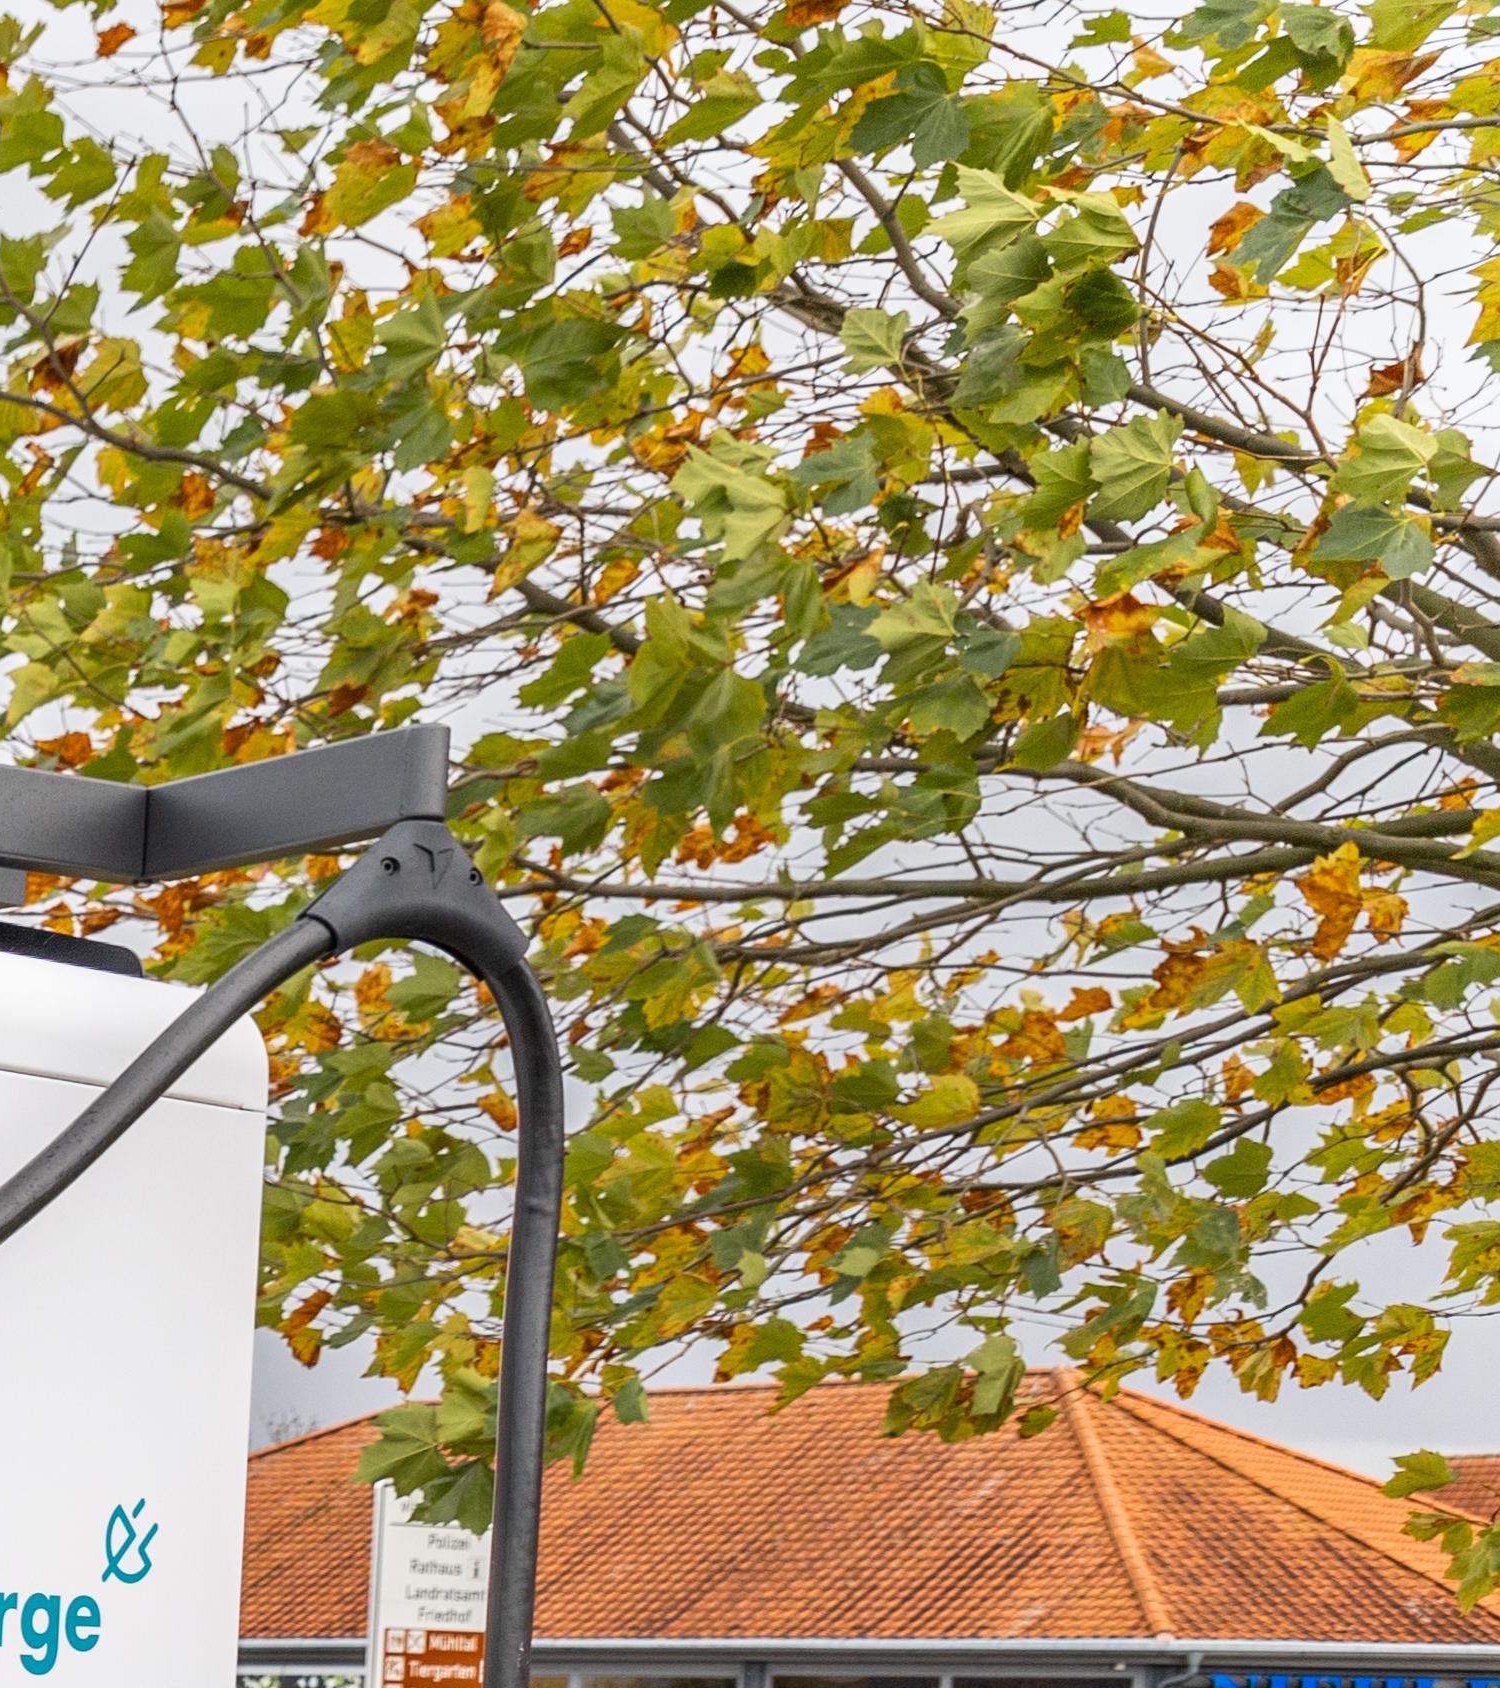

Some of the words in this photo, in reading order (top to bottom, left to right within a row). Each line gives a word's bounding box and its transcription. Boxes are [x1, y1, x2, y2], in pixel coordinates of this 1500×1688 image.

[427, 1533, 471, 1551] Polizei
[409, 1558, 462, 1577] Rathaus
[405, 1585, 485, 1602] Landratsamt
[418, 1606, 473, 1623] Friedhof
[428, 1633, 479, 1652] Mühltal
[408, 1660, 478, 1683] Tiergarten
